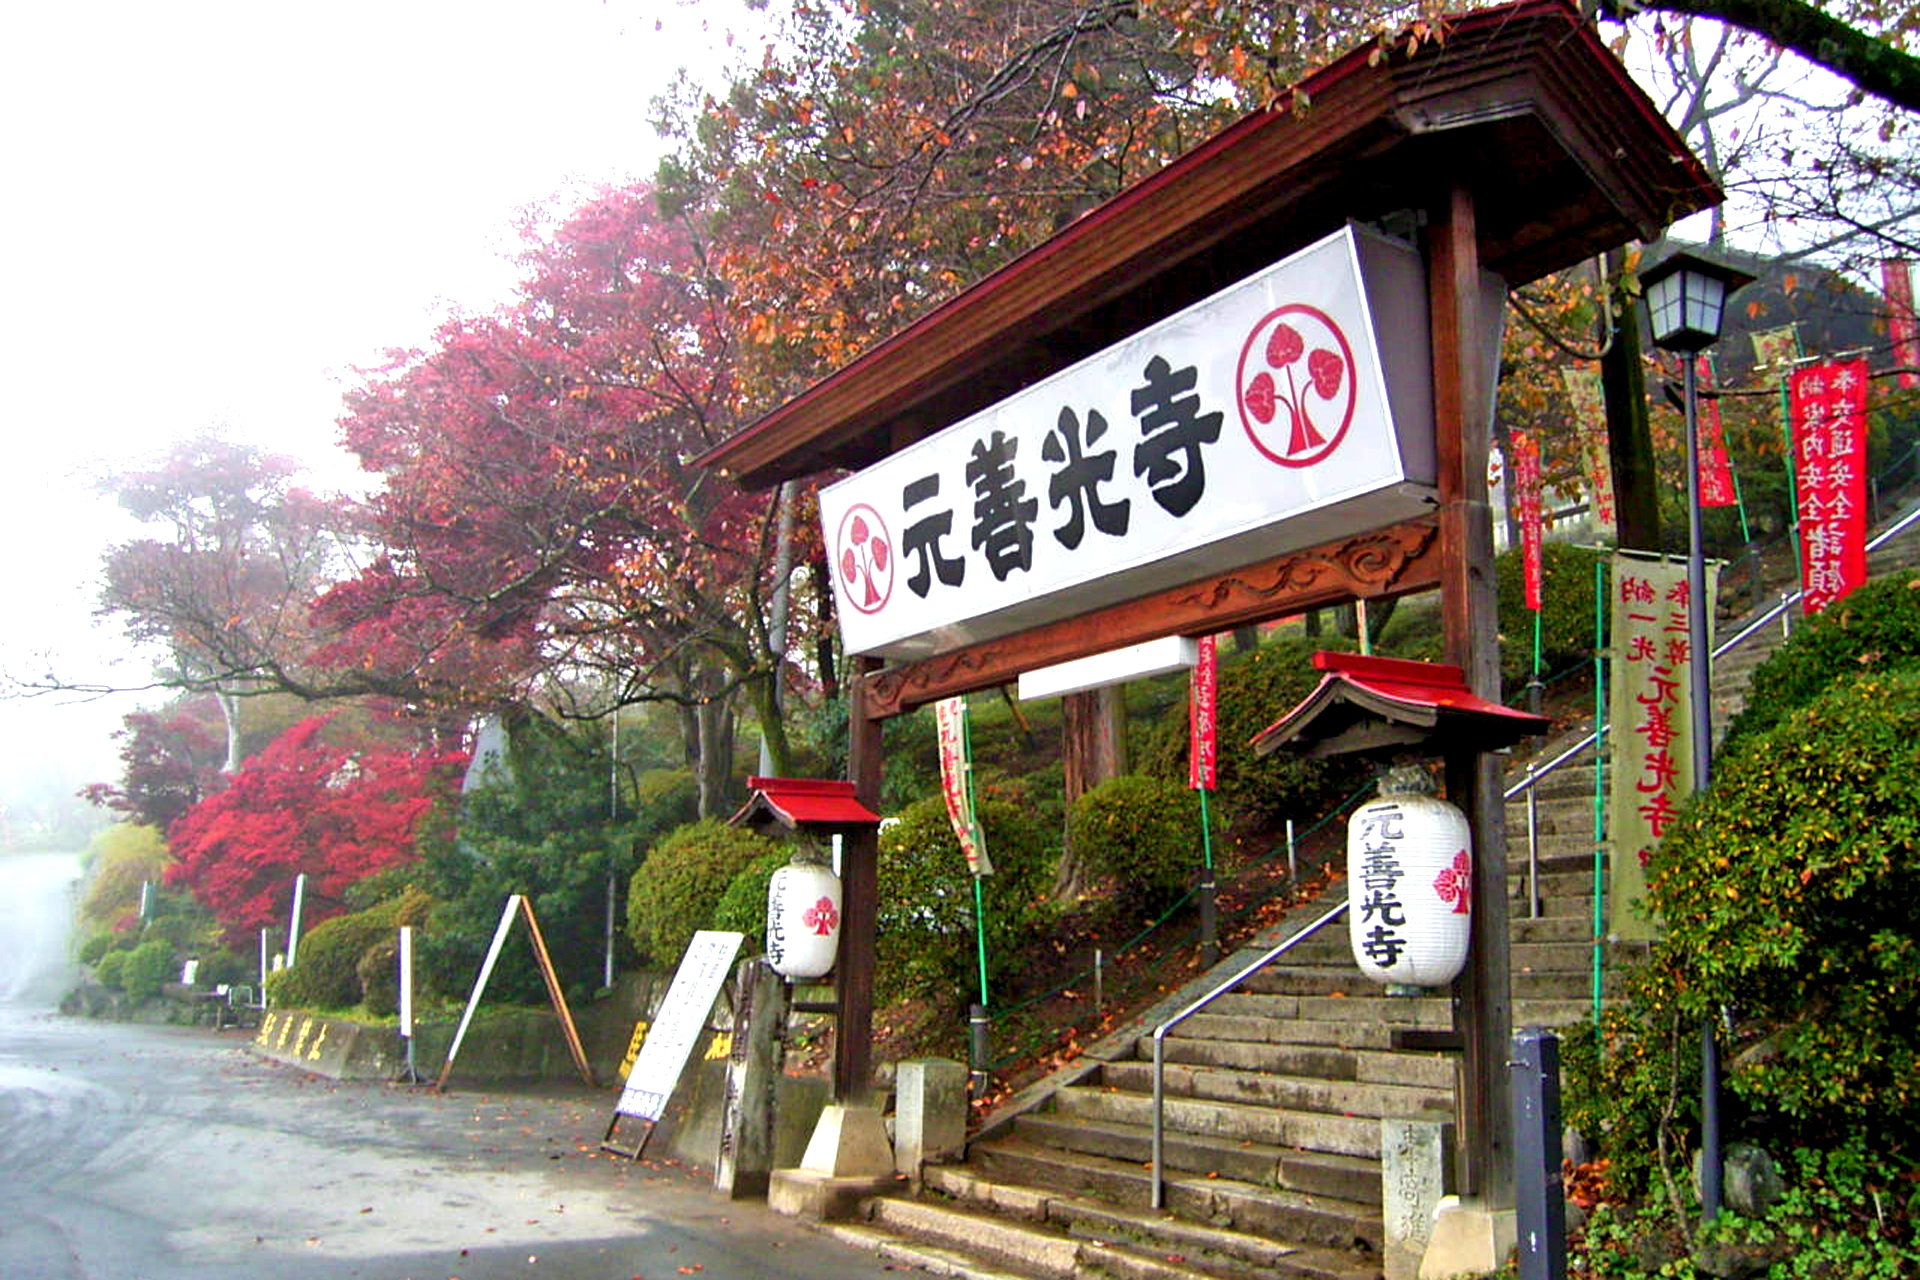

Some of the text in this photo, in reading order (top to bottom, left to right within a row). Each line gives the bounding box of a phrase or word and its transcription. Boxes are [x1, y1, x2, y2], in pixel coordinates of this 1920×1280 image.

[903, 355, 1223, 598] 元善光寺
[1359, 805, 1407, 967] 元善光寺
